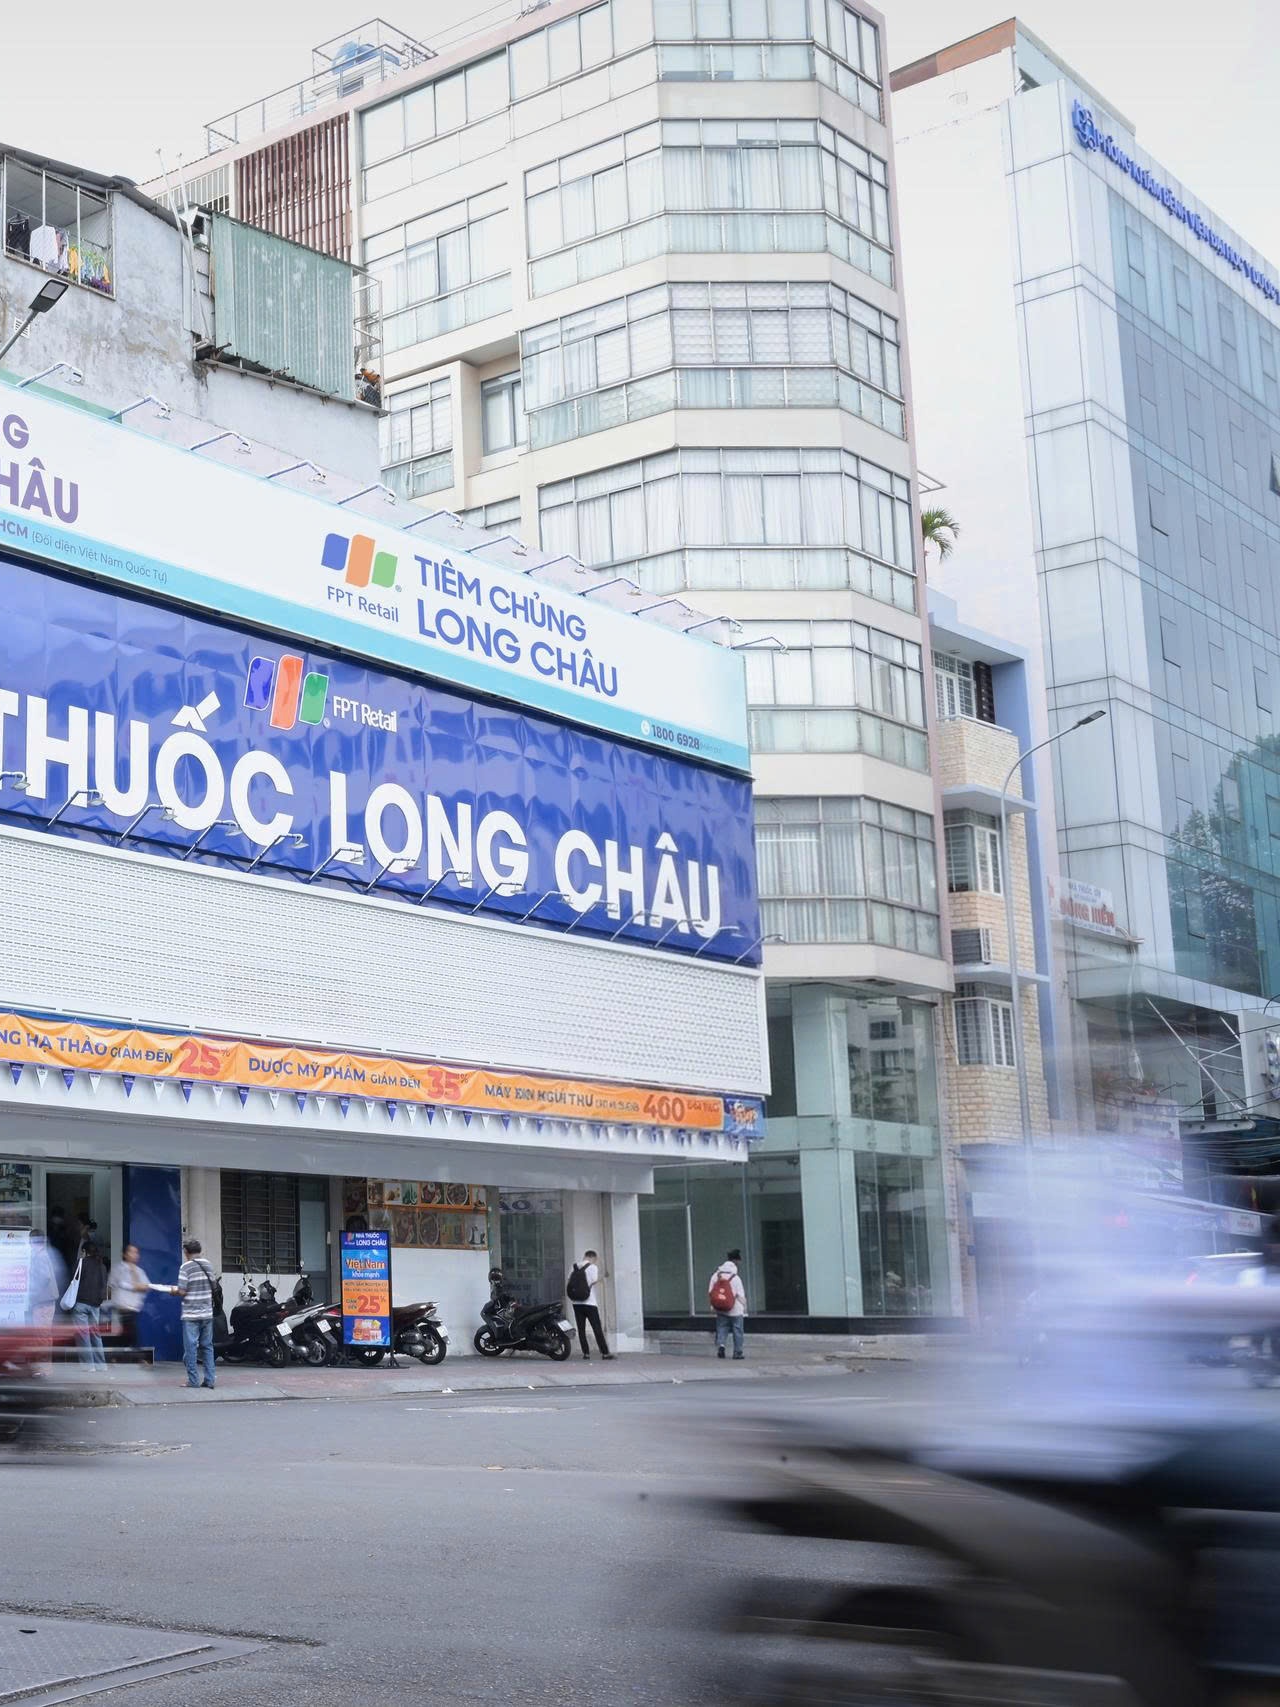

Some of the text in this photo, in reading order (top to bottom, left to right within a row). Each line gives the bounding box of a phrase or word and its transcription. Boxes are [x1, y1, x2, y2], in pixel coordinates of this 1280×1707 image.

[100, 551, 122, 568] Nam
[327, 585, 399, 623] FPT Retail
[413, 553, 586, 642] TIÊM CHỦNG
[417, 598, 618, 697] LONG CHÂU
[332, 695, 398, 733] FPT Retail
[651, 724, 675, 742] 1800
[676, 732, 700, 750] 6928
[329, 770, 529, 899] LONG
[554, 831, 721, 940] CHÂU
[26, 1033, 53, 1053] HẠ
[56, 1033, 108, 1057] THẢO
[110, 1043, 142, 1061] GIẢM
[145, 1046, 173, 1064] ĐẾN
[248, 1057, 293, 1078] DƯỢC
[297, 1061, 321, 1077] MỸ
